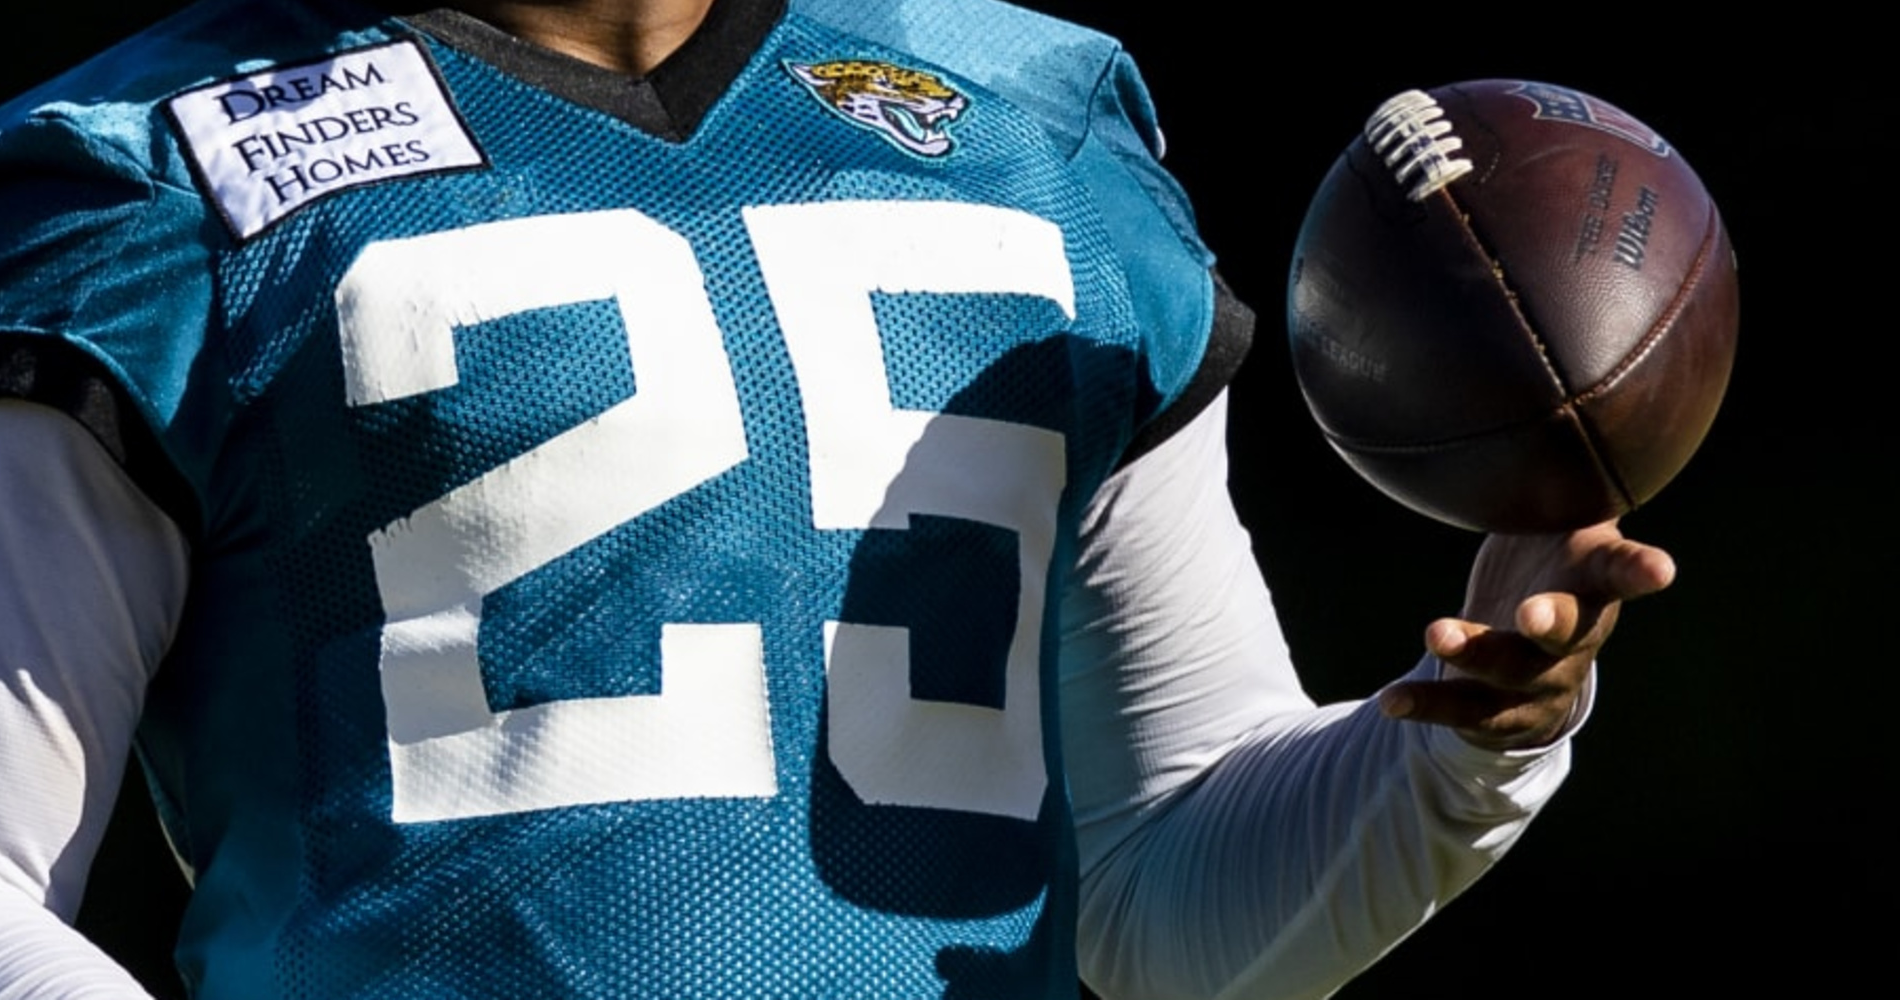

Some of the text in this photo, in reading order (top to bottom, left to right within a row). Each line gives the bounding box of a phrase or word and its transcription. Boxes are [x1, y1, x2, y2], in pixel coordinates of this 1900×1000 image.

[215, 62, 386, 126] DREAM
[232, 101, 420, 175] FINDERS
[264, 140, 431, 206] HOMES
[1613, 185, 1659, 270] Wilson
[334, 199, 1077, 825] 25
